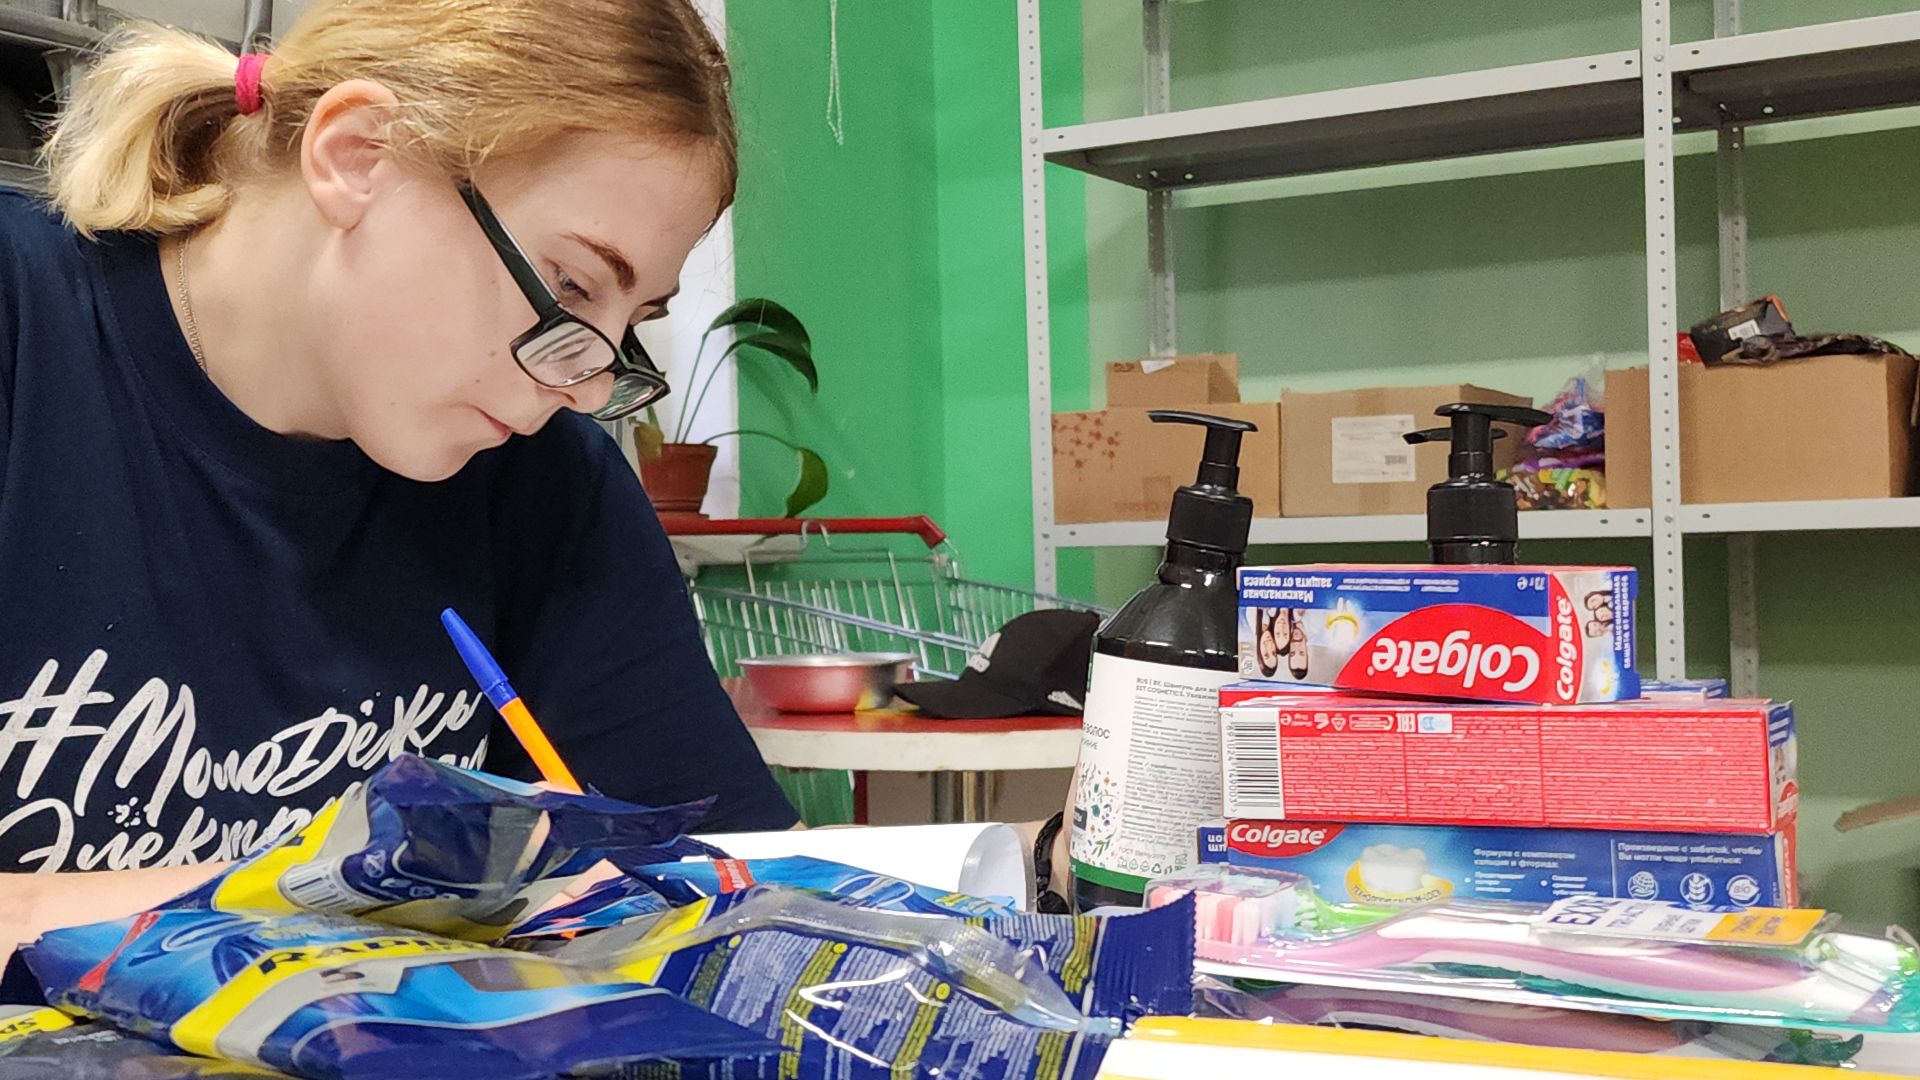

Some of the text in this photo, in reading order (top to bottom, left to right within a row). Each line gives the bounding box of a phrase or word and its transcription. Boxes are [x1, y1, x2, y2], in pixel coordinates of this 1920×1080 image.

[1282, 577, 1294, 587] от
[1295, 576, 1333, 588] защита
[1372, 630, 1540, 693] Colgate
[1556, 598, 1578, 701] Colgate
[1230, 824, 1326, 848] Colgate
